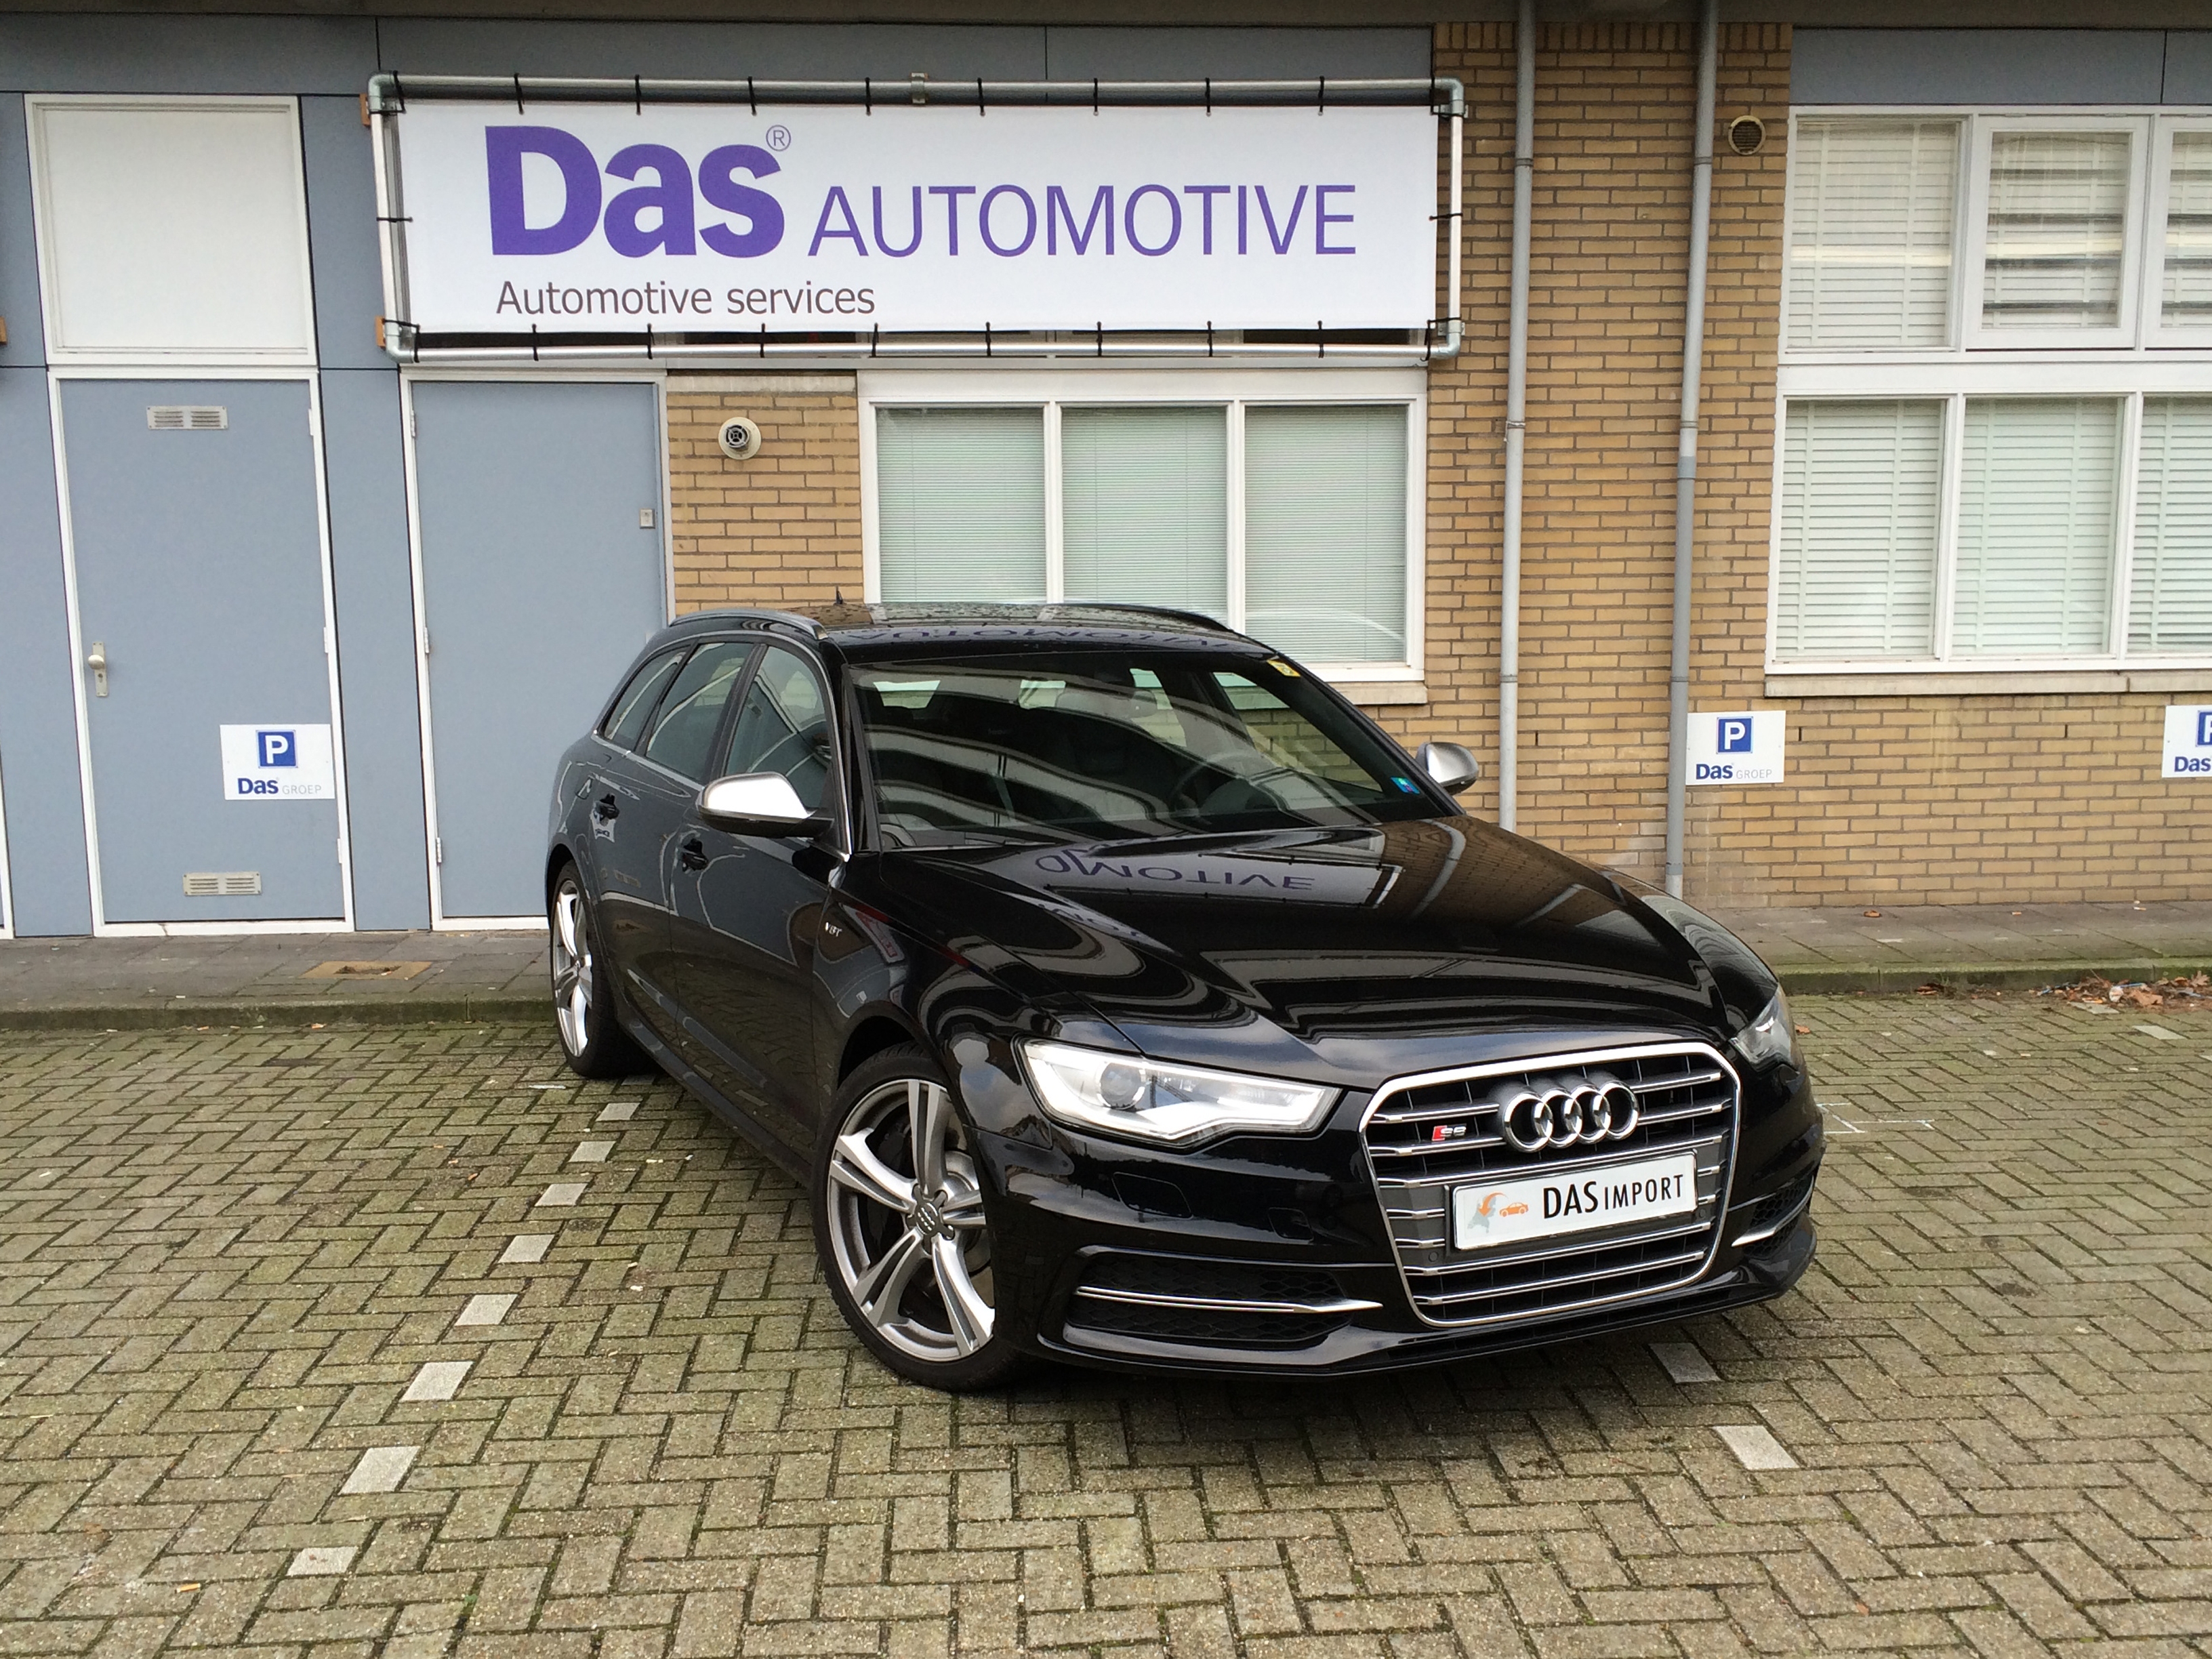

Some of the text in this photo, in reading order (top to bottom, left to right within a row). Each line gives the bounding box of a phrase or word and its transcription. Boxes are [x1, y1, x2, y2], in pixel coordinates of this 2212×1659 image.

[808, 184, 1355, 258] AUTOMOTIVE
[496, 280, 876, 314] Automotive services
[265, 735, 289, 764] P
[1724, 722, 1746, 750] P
[1696, 764, 1772, 779] Das GROEP
[2174, 756, 2211, 773] Das
[237, 777, 322, 795] Das GROEP
[1542, 1174, 1683, 1219] DAS IMPORT
